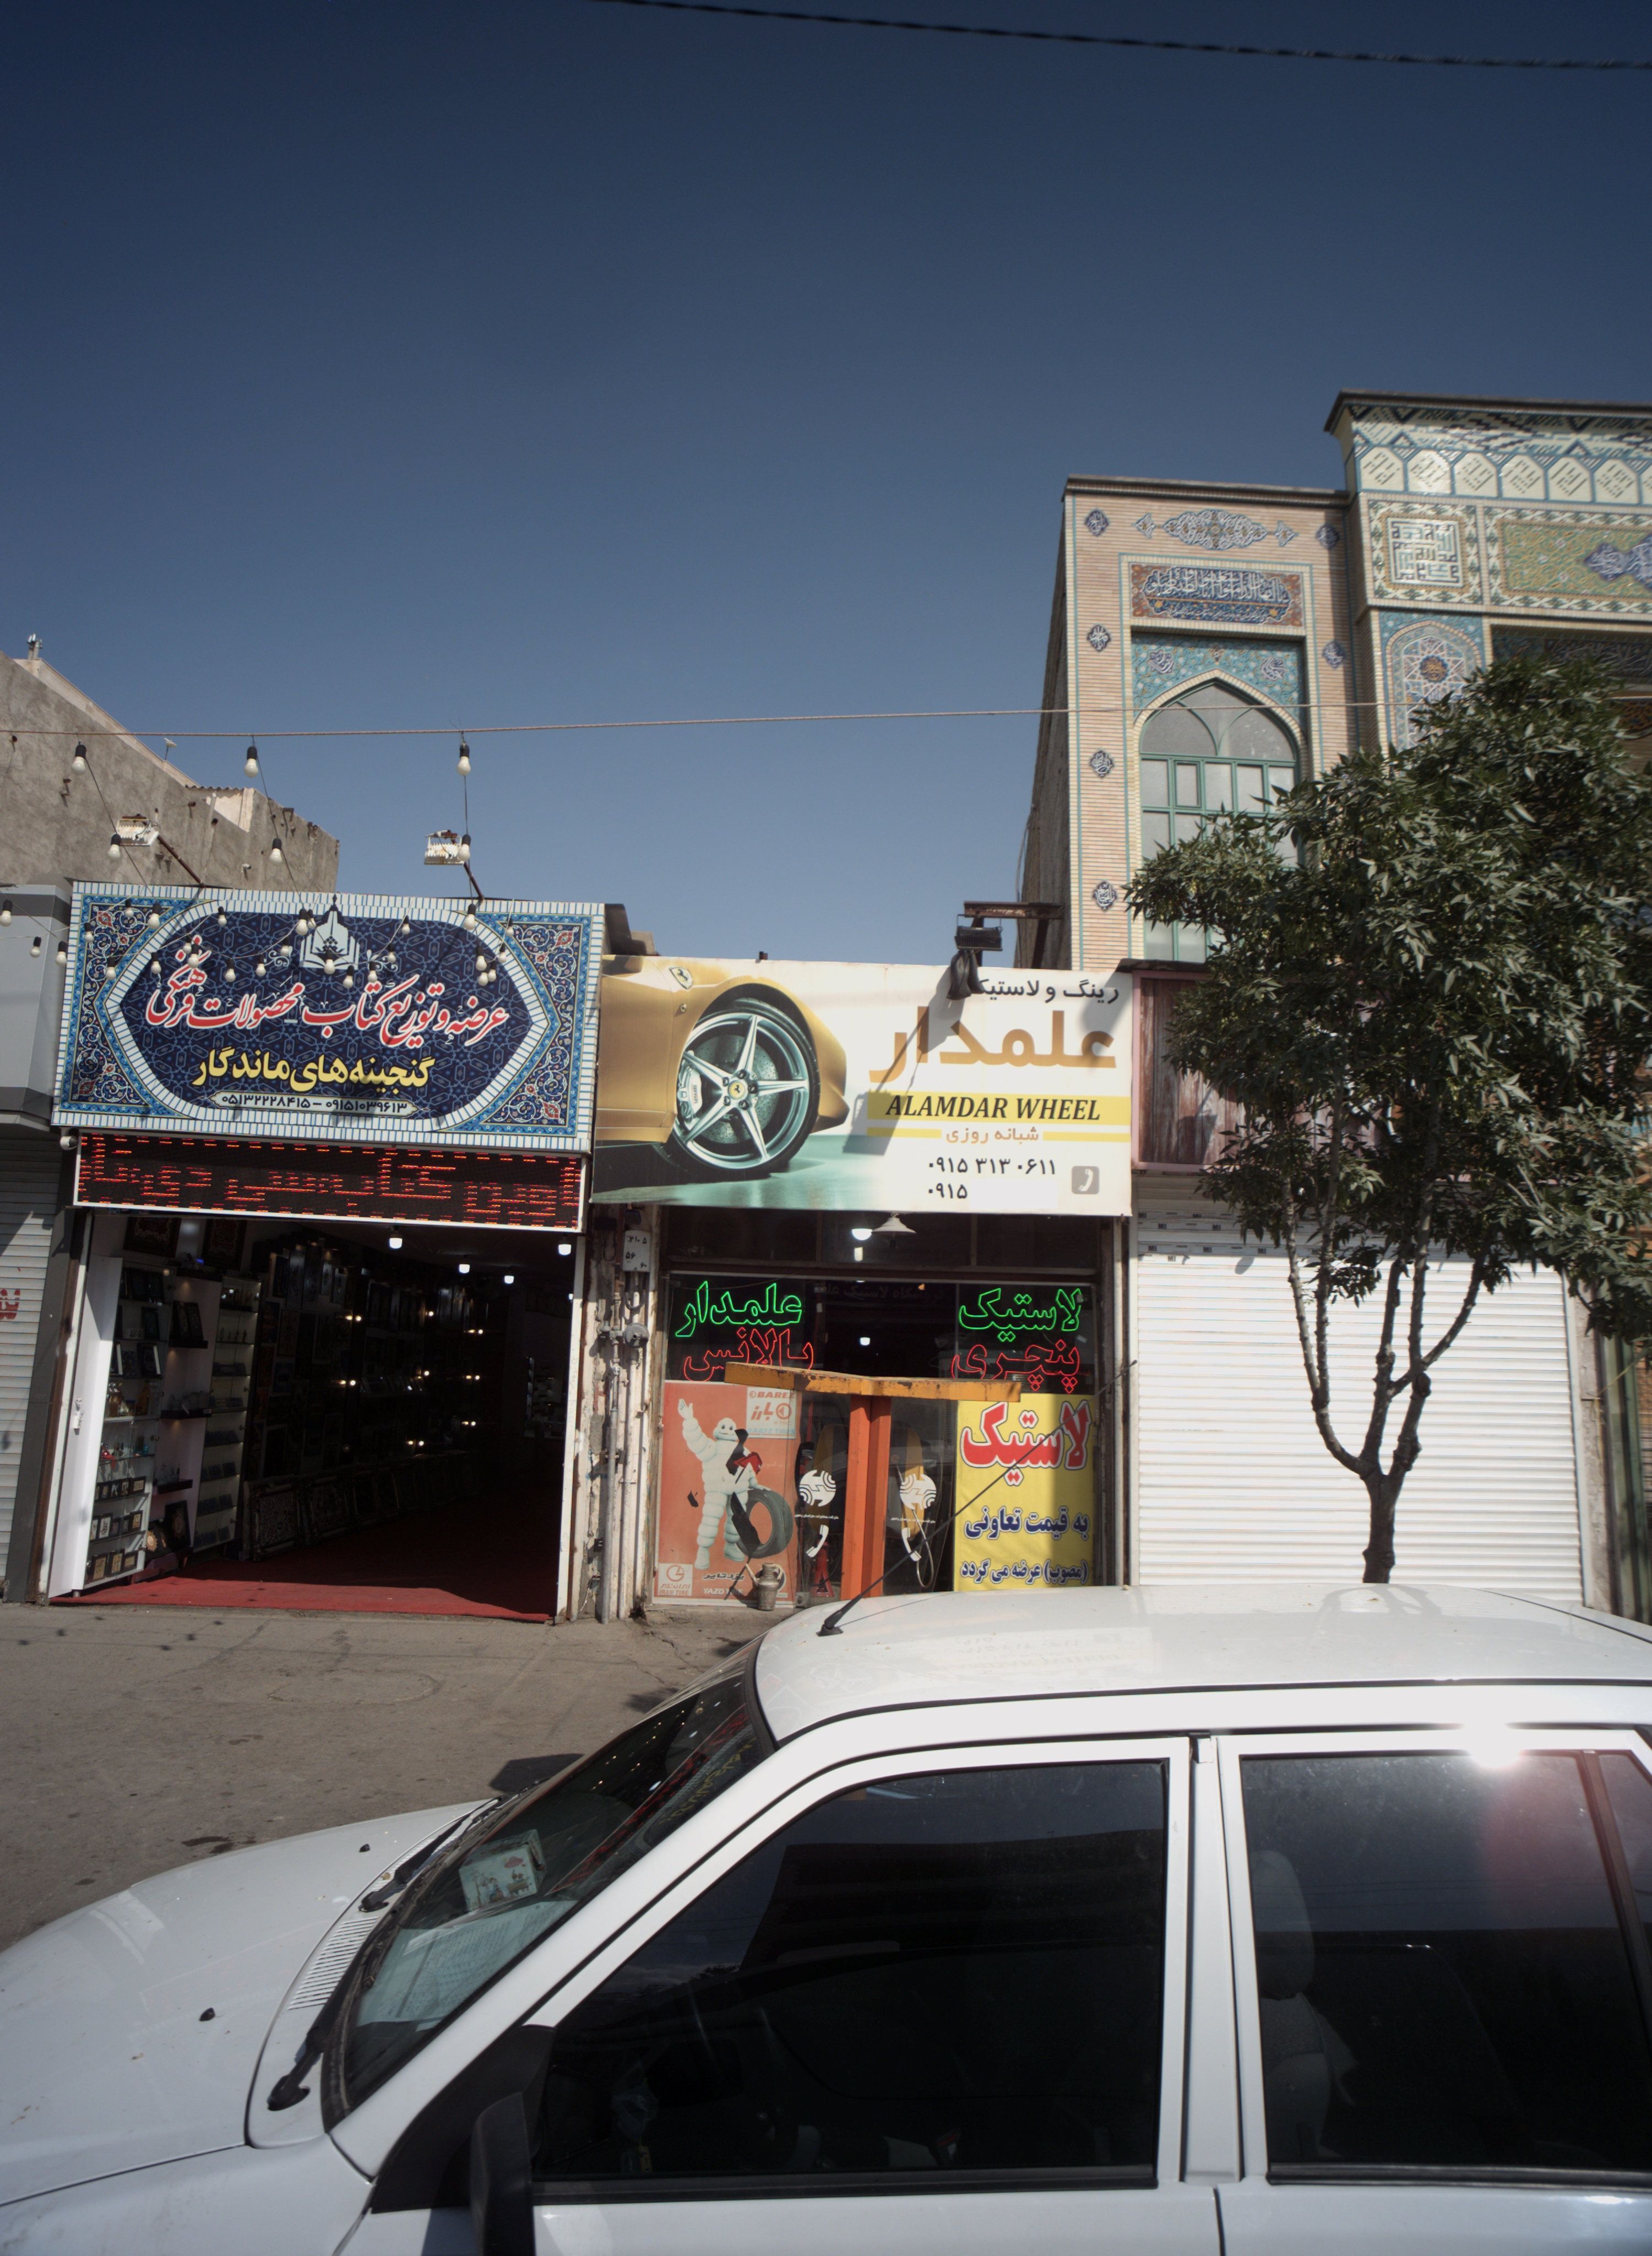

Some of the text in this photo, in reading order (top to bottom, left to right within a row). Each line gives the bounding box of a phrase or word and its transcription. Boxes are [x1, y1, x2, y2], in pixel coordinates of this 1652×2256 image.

[145, 934, 509, 1048] عرضه و توزیع کتاب محصولات فرهنگی
[1045, 986, 1056, 1004] و
[1063, 979, 1119, 1004] رینگ
[868, 1006, 1117, 1083] علمدار
[191, 1045, 291, 1086] ماندگار
[885, 1094, 1101, 1121] ALAMDAR WHEEL
[945, 1126, 1039, 1145] شبانه روزی
[928, 1156, 1056, 1175] ۰۹۱۵ ۳۱۳ ۰۶۱۱
[928, 1183, 968, 1200] ۰۹۱۵
[675, 1281, 802, 1337] علمدار
[959, 1288, 1083, 1342] لاستیک
[950, 1339, 1080, 1394] پنچری
[960, 1399, 1092, 1487] لاستیک
[965, 1505, 1090, 1541] به قیمت تعاونی
[961, 1558, 991, 1583] گردد
[991, 1565, 1010, 1583] می
[1011, 1559, 1042, 1585] عرضه
